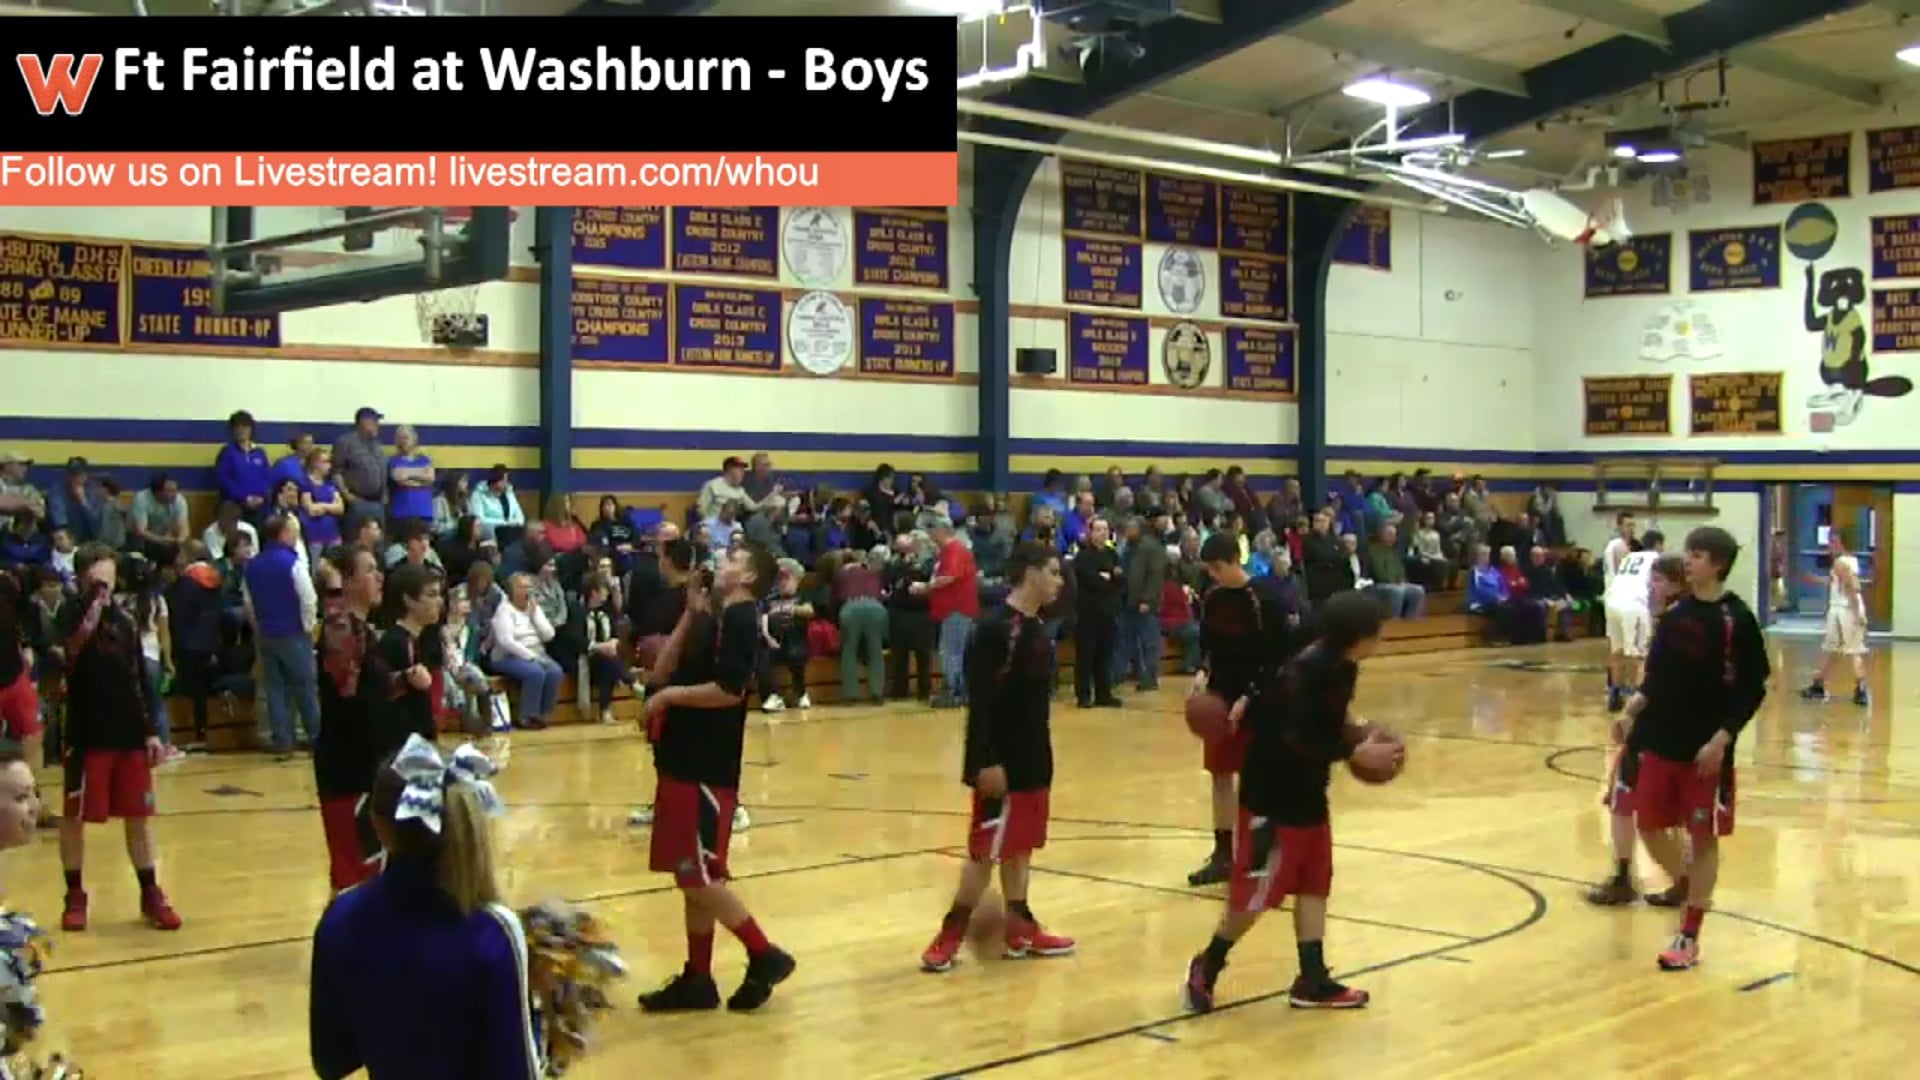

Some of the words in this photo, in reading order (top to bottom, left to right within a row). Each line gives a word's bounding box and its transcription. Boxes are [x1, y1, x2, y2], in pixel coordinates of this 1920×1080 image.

[573, 220, 647, 239] CHAMPIONS
[49, 262, 104, 281] CLASS
[27, 304, 48, 322] OF
[54, 306, 107, 329] MAINE
[139, 314, 181, 334] STATE
[194, 315, 271, 338] RUNNER-UP
[576, 319, 649, 337] CHAMPIONS
